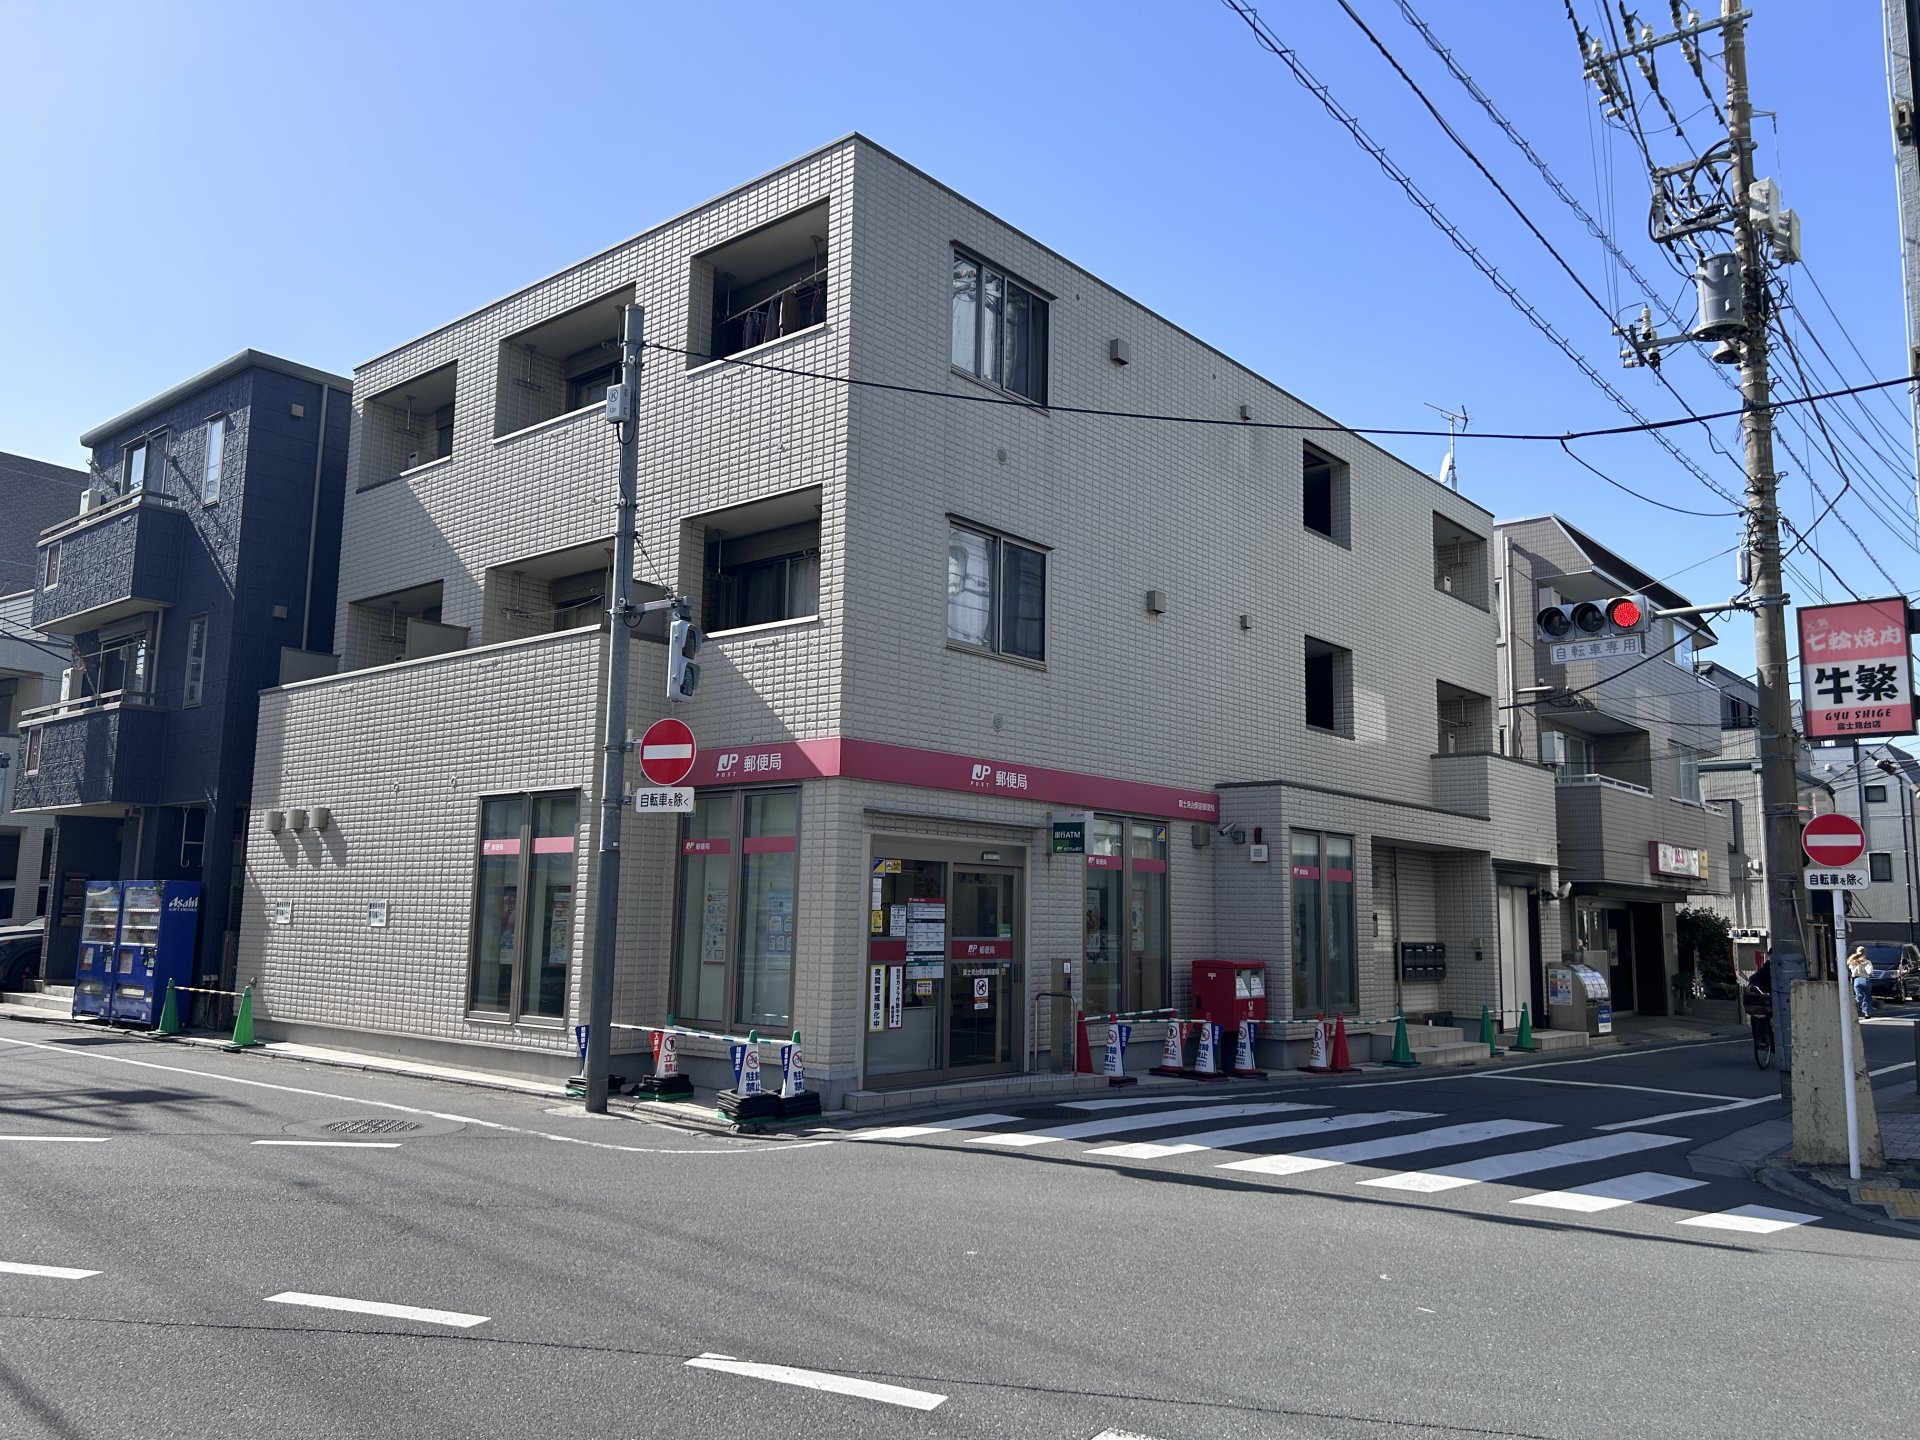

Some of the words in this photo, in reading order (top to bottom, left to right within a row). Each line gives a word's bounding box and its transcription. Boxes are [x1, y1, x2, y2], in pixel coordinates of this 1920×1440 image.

[1806, 625, 1902, 652] 七輪焼肉
[1556, 638, 1637, 661] 自転車専用
[1815, 664, 1899, 704] 牛繁
[1825, 711, 1849, 721] GYU
[1855, 708, 1892, 719] SHIGE
[1837, 720, 1881, 731] 富士見台店
[743, 753, 782, 773] 郵便局
[970, 780, 989, 788] POST
[995, 770, 1028, 790] 郵便局
[640, 792, 689, 808] 自転車を除く
[1054, 831, 1081, 839] 銀行ATM
[1809, 874, 1863, 886] 自転車を除く
[168, 896, 199, 908] Asahi
[979, 945, 996, 954] 郵便局
[873, 968, 881, 1028] 夜間警戒強化中
